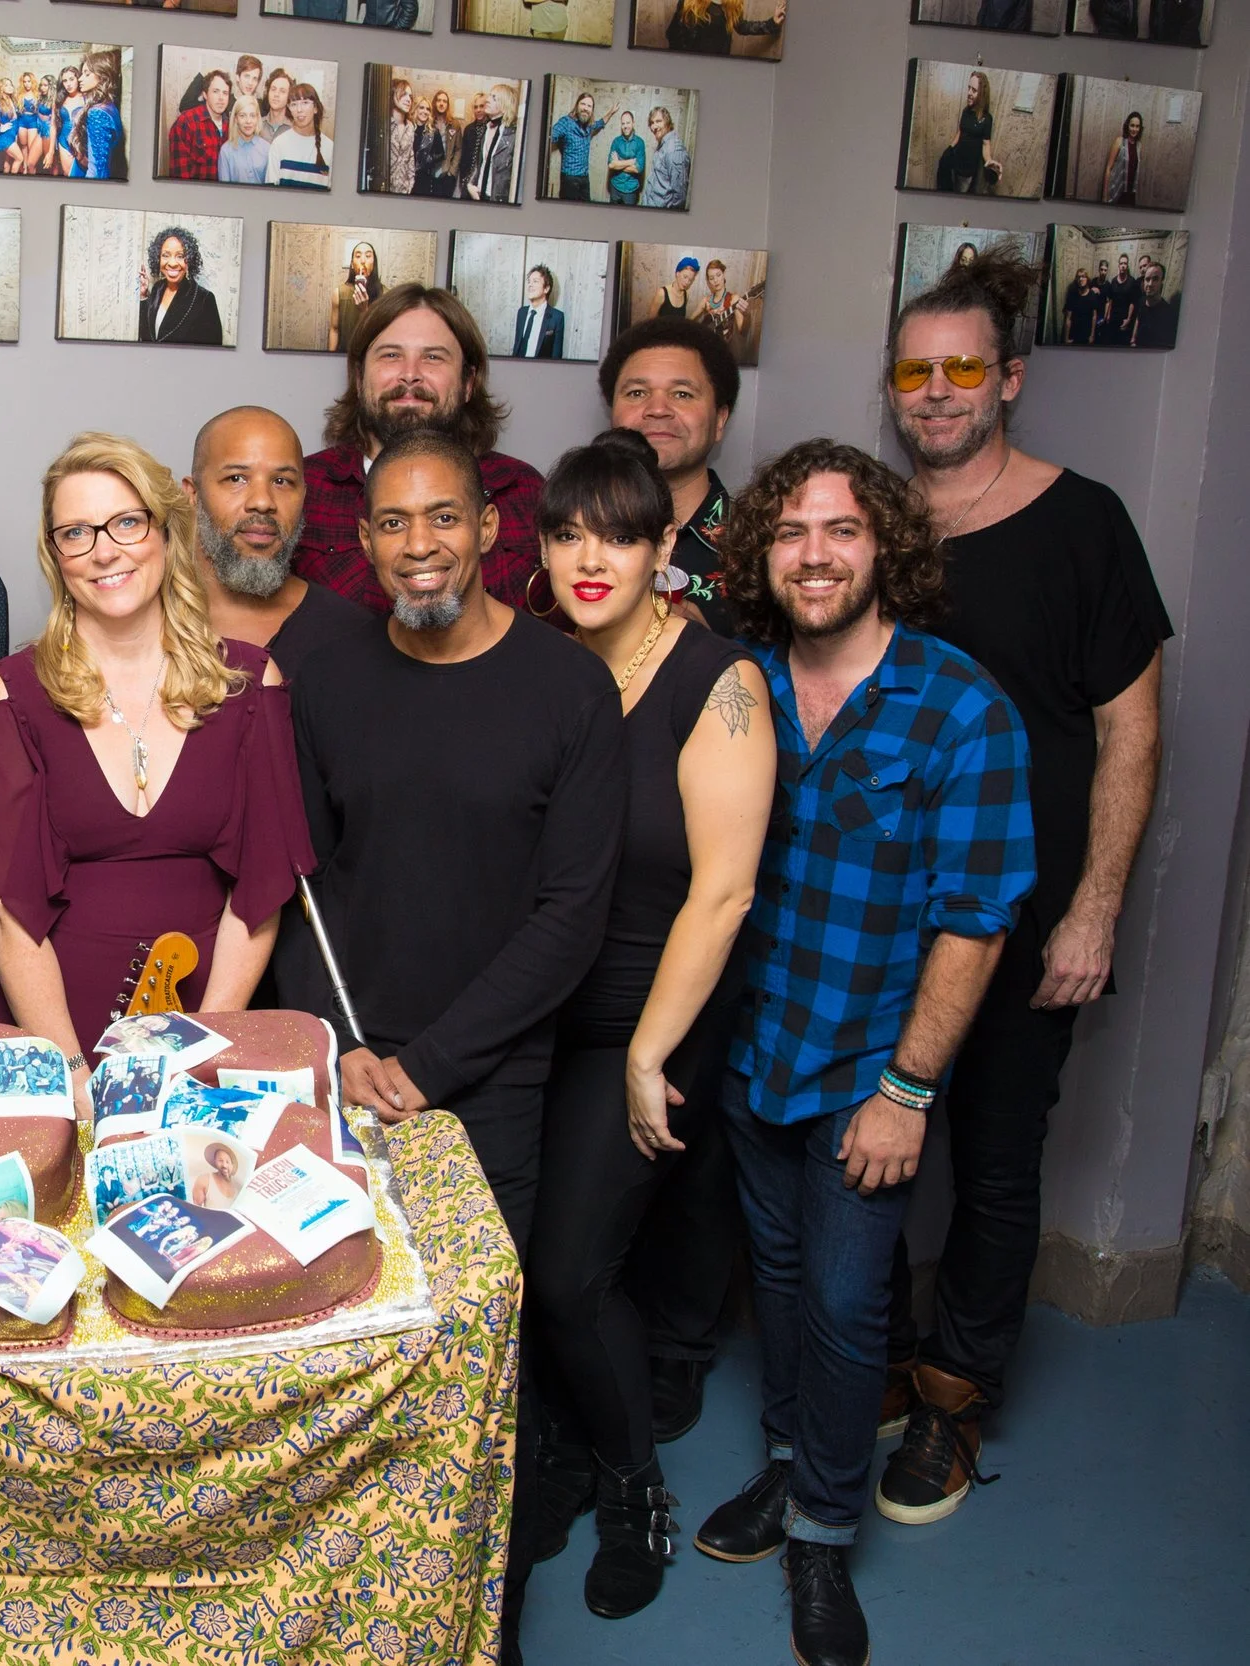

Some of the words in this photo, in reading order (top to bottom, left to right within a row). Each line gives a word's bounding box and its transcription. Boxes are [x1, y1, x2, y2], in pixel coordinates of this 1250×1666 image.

[164, 965, 174, 1006] STRATOCASTER
[246, 1158, 295, 1190] TEDESCHI
[255, 1172, 299, 1199] TRUCKS
